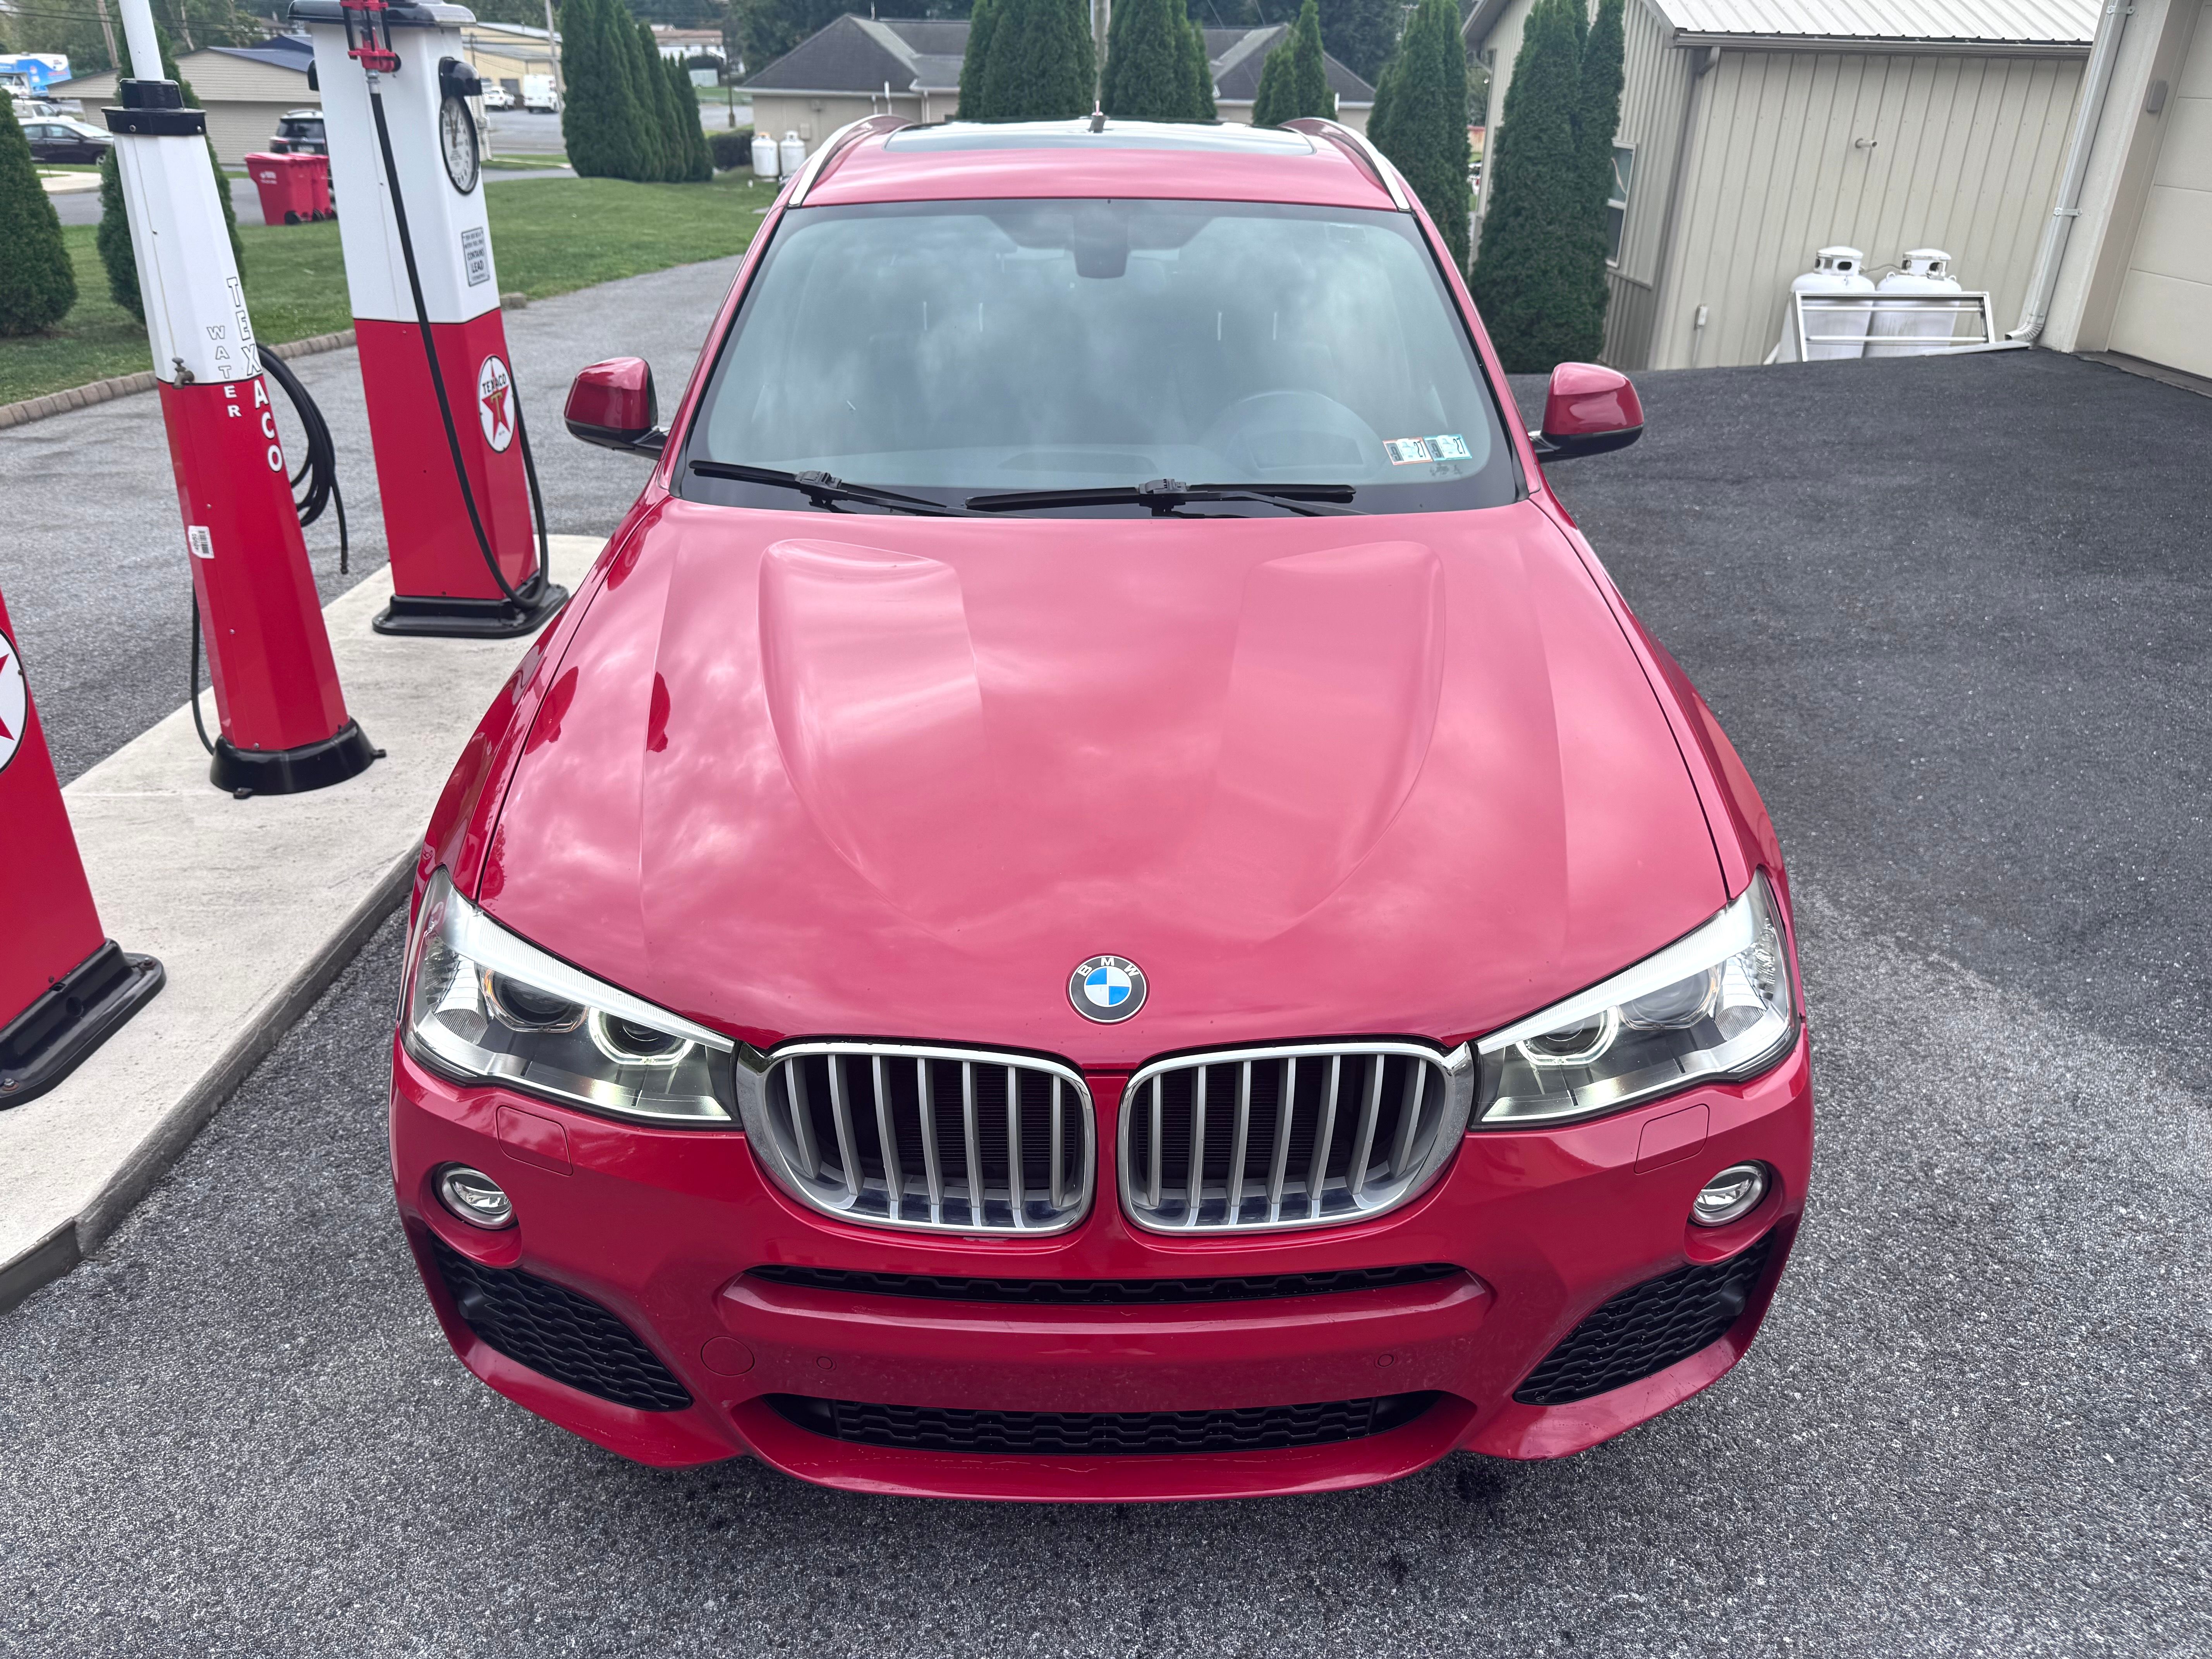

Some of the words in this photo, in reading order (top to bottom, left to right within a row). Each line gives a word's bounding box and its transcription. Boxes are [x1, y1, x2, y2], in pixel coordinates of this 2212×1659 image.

[472, 260, 484, 273] LEAD
[206, 325, 242, 417] WATER
[227, 276, 283, 472] TEXACO
[482, 373, 507, 394] TEXACO
[1413, 441, 1426, 459] 27
[1453, 438, 1466, 455] 27
[1077, 957, 1140, 977] BMW
